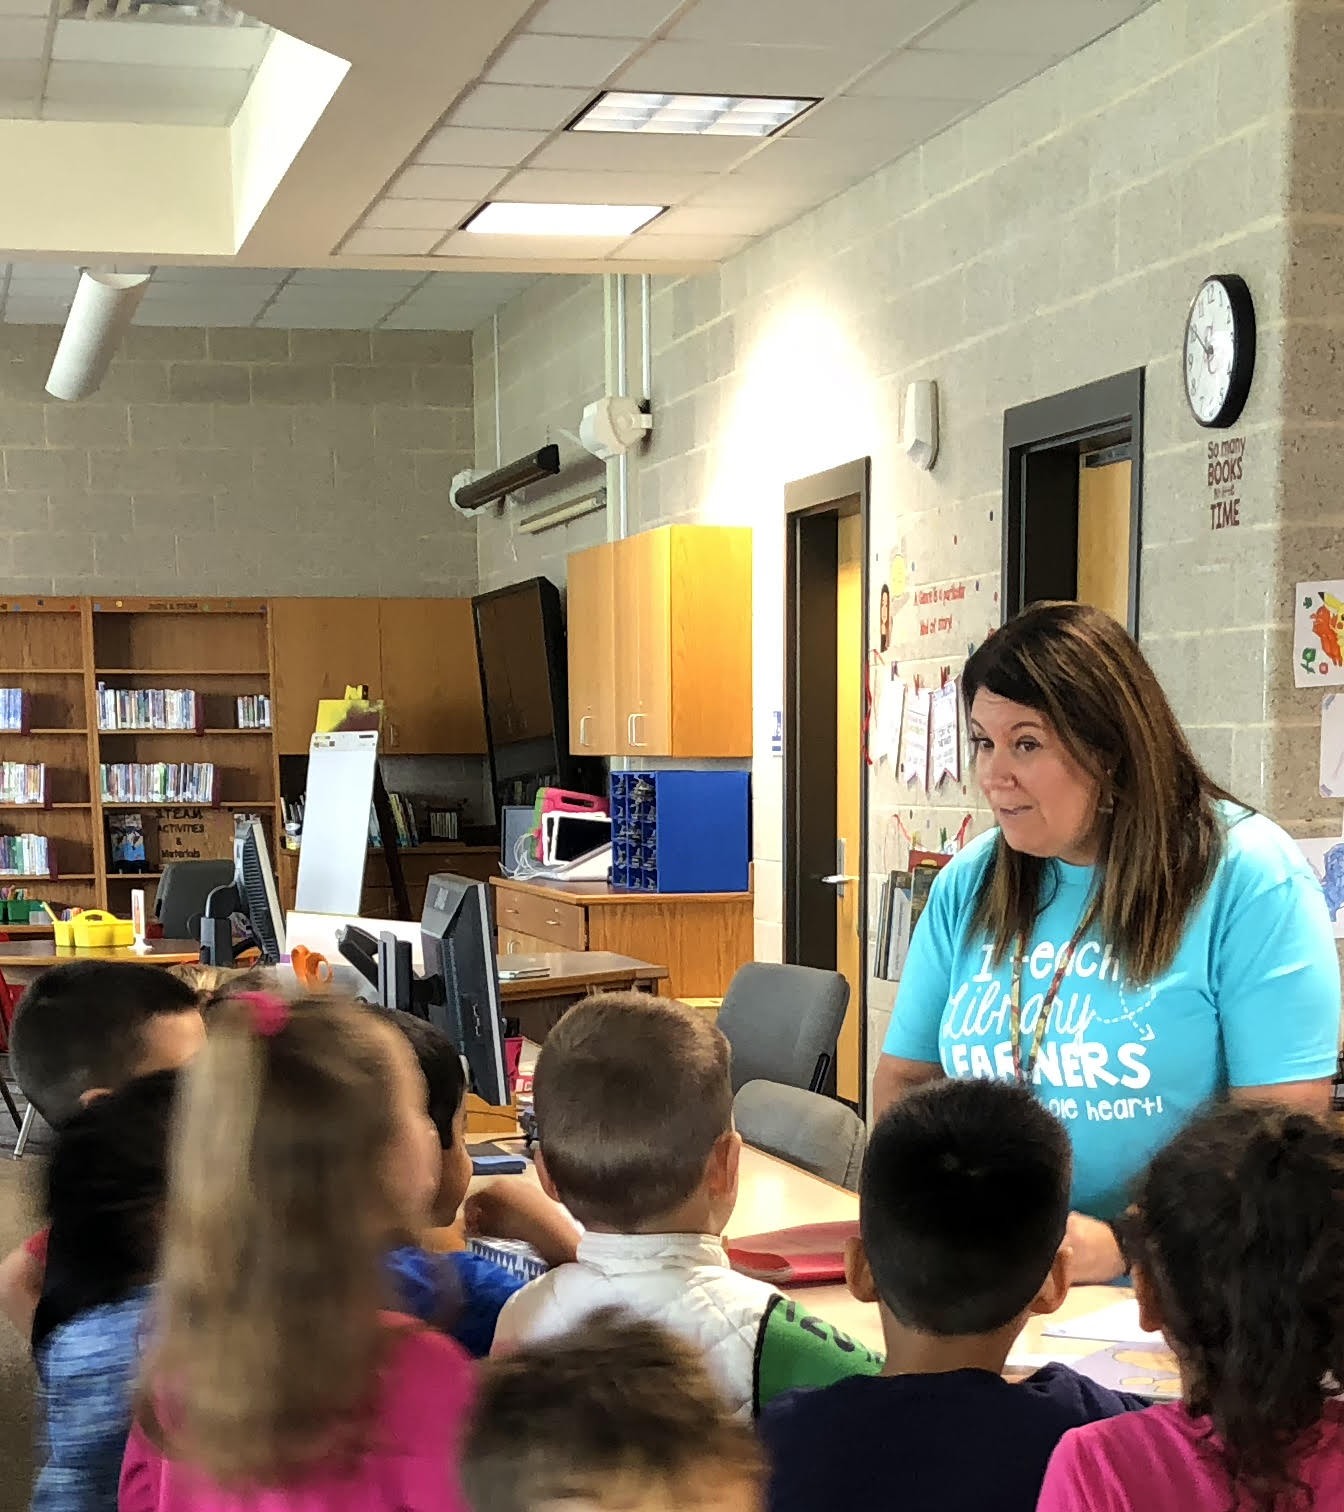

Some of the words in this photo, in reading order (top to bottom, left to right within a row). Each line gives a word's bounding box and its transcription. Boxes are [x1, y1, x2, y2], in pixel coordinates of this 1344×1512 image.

[1208, 456, 1242, 486] BOOKS
[1210, 498, 1240, 530] TIME
[157, 807, 204, 819] STEAM
[158, 823, 205, 834] ACTIVITIES
[161, 848, 201, 859] Materials
[972, 943, 994, 983] I
[943, 981, 1097, 1044] Library
[1086, 1096, 1164, 1121] heart!
